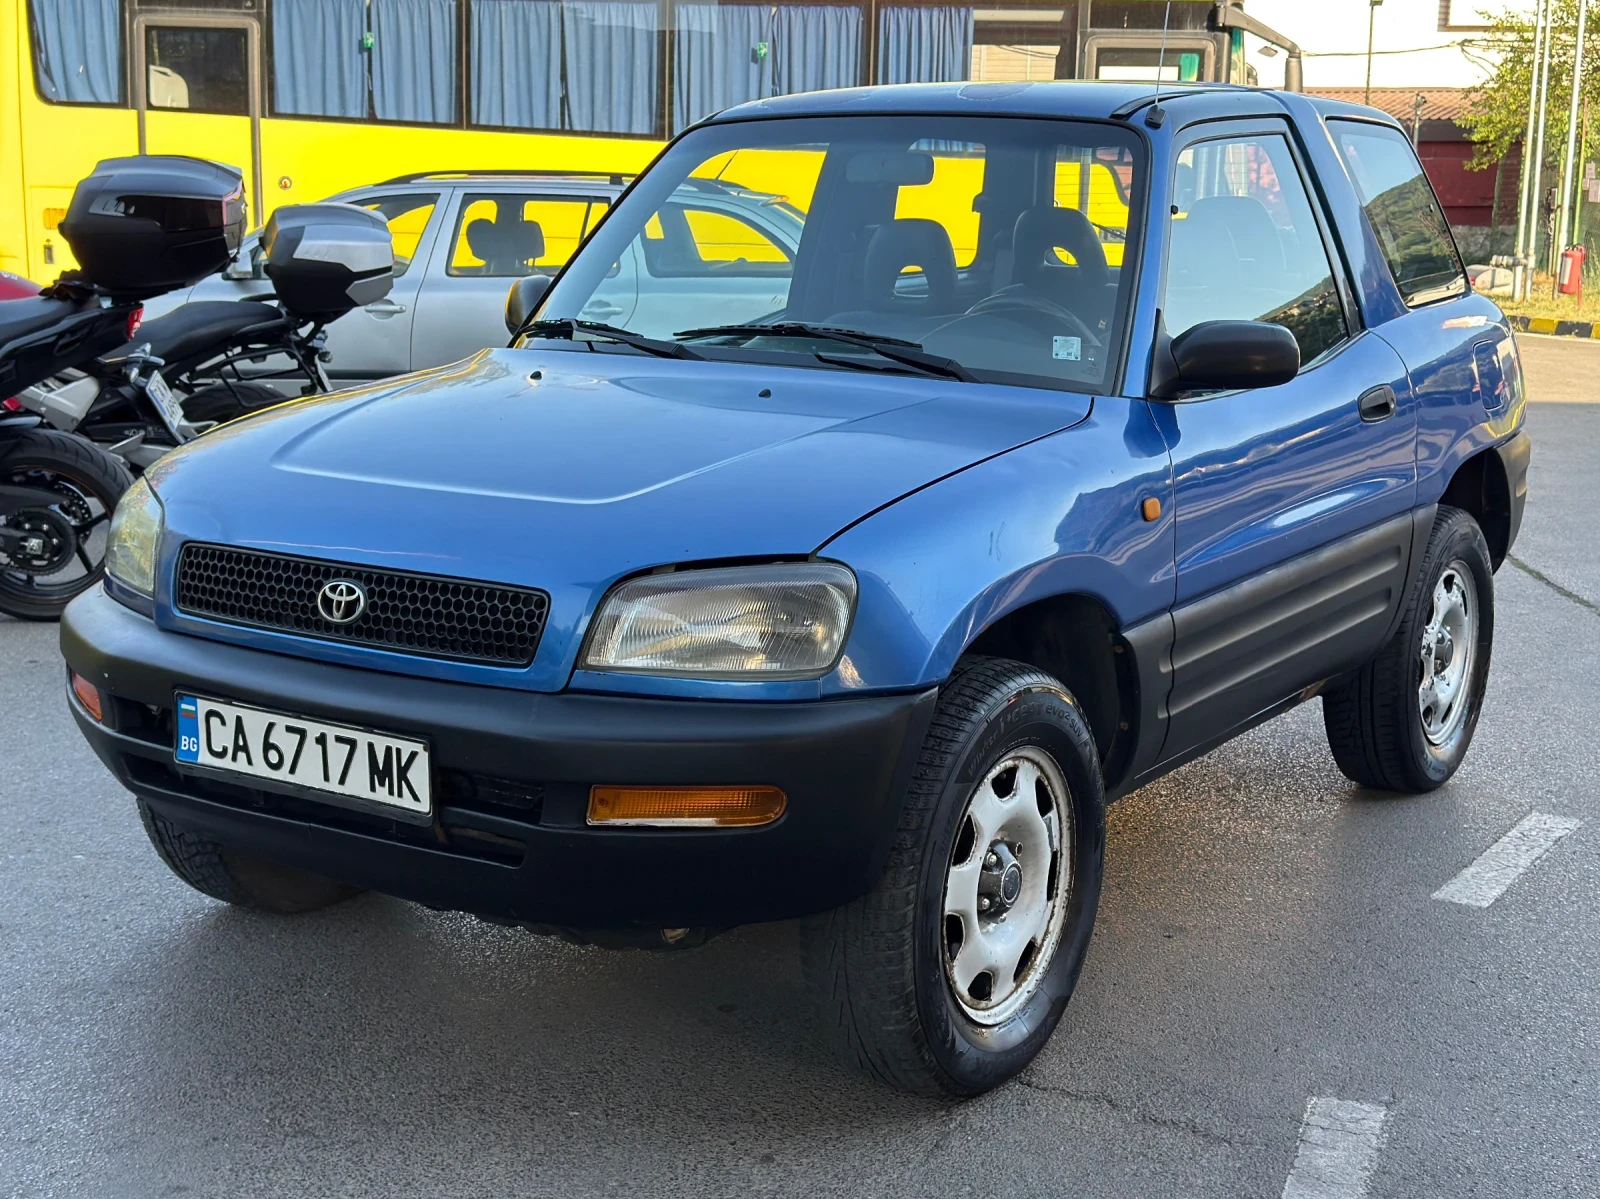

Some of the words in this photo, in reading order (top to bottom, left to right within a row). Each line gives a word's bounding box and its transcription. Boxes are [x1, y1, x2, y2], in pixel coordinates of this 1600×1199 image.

[1069, 718, 1084, 737] SUV
[181, 736, 198, 752] BG
[205, 709, 253, 766] CA
[262, 722, 357, 785] 6717
[367, 741, 421, 802] MK
